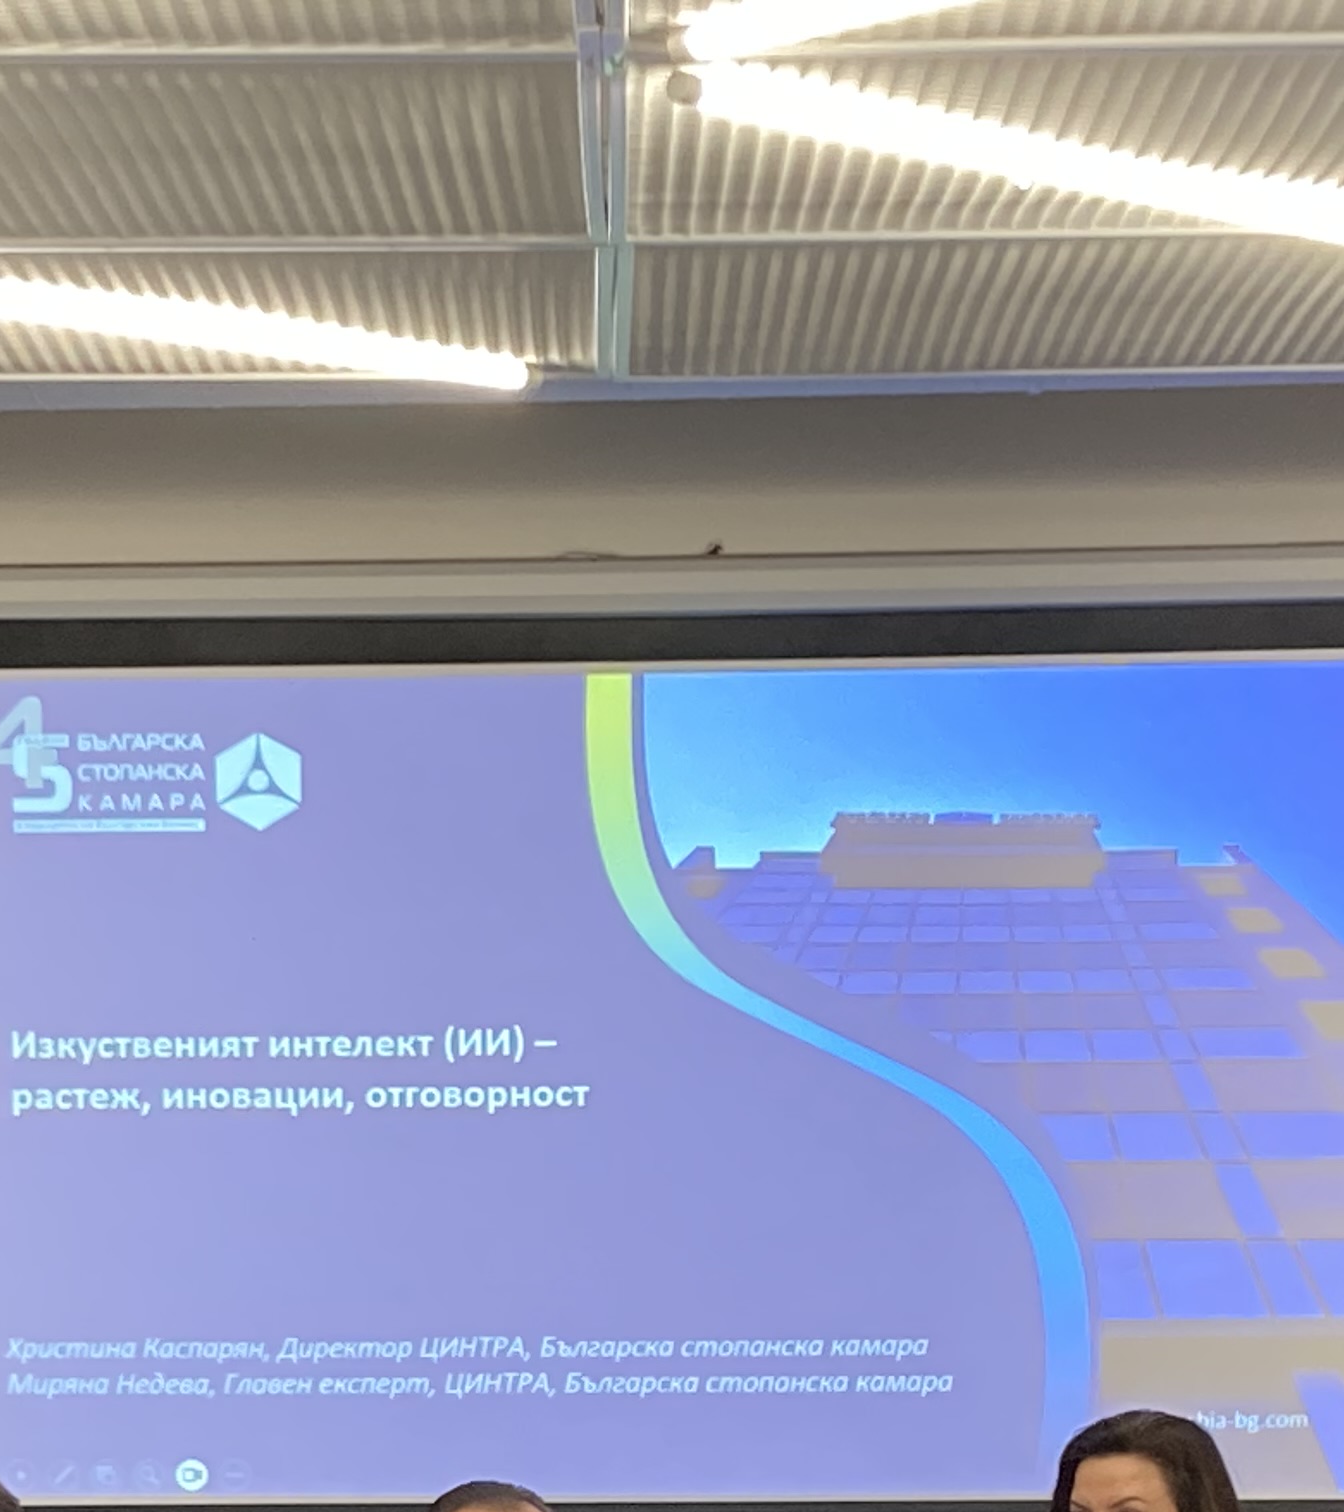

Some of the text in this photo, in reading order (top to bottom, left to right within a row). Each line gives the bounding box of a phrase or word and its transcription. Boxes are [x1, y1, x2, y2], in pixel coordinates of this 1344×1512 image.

[77, 733, 205, 752] БЪЛГАРСКА
[77, 762, 206, 782] СТОПАНСКА
[77, 793, 206, 812] КАМАРА
[11, 1030, 260, 1065] Изкуственият
[269, 1034, 435, 1058] интелект
[444, 1024, 525, 1064] (ИИ)
[11, 1085, 590, 1117] растеж, иновации, отговорност
[7, 1335, 930, 1365] Христина Каспарян, Директор ЦИНТРА, Българска стопанска камара
[8, 1371, 954, 1400] Миряна Недева, Главен експерт, ЦИНТРА, Българска стопанска камара
